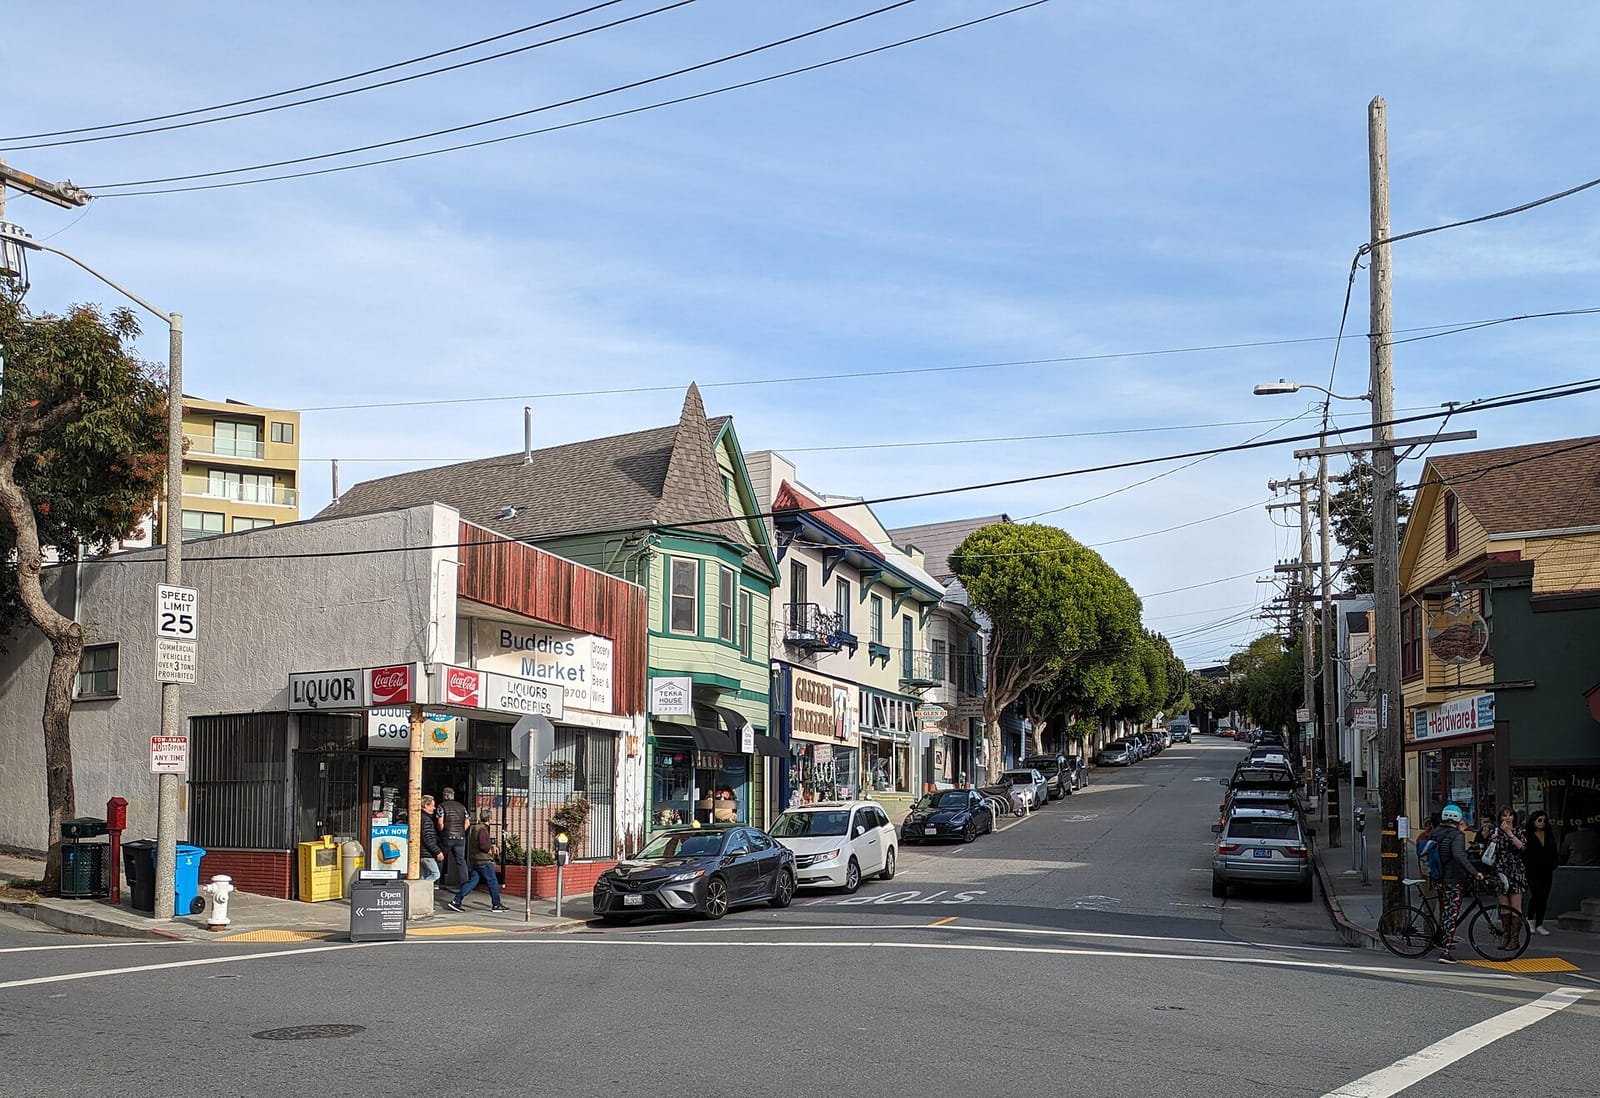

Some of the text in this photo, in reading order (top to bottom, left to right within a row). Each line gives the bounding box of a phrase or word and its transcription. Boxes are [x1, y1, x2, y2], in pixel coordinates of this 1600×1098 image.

[161, 590, 195, 602] SPEED
[164, 601, 191, 612] LIMIT
[161, 612, 194, 634] 25
[159, 643, 194, 653] COMMERCIAL
[500, 629, 575, 657] Buddies
[592, 641, 610, 658] Grocery
[162, 653, 191, 662] VEHICLES
[159, 661, 194, 671] OVER 3 TONS
[521, 657, 585, 682] Market
[592, 658, 608, 671] Liquor
[158, 671, 194, 680] PROHIBITED
[294, 678, 355, 708] LIQUOR
[507, 681, 548, 700] LIQUORS
[564, 688, 587, 699] 9700
[500, 696, 552, 714] GROCERIES
[1430, 709, 1470, 735] Hardware
[152, 743, 186, 752] NO STOPPING
[170, 754, 185, 762] TIME
[380, 890, 401, 899] Open
